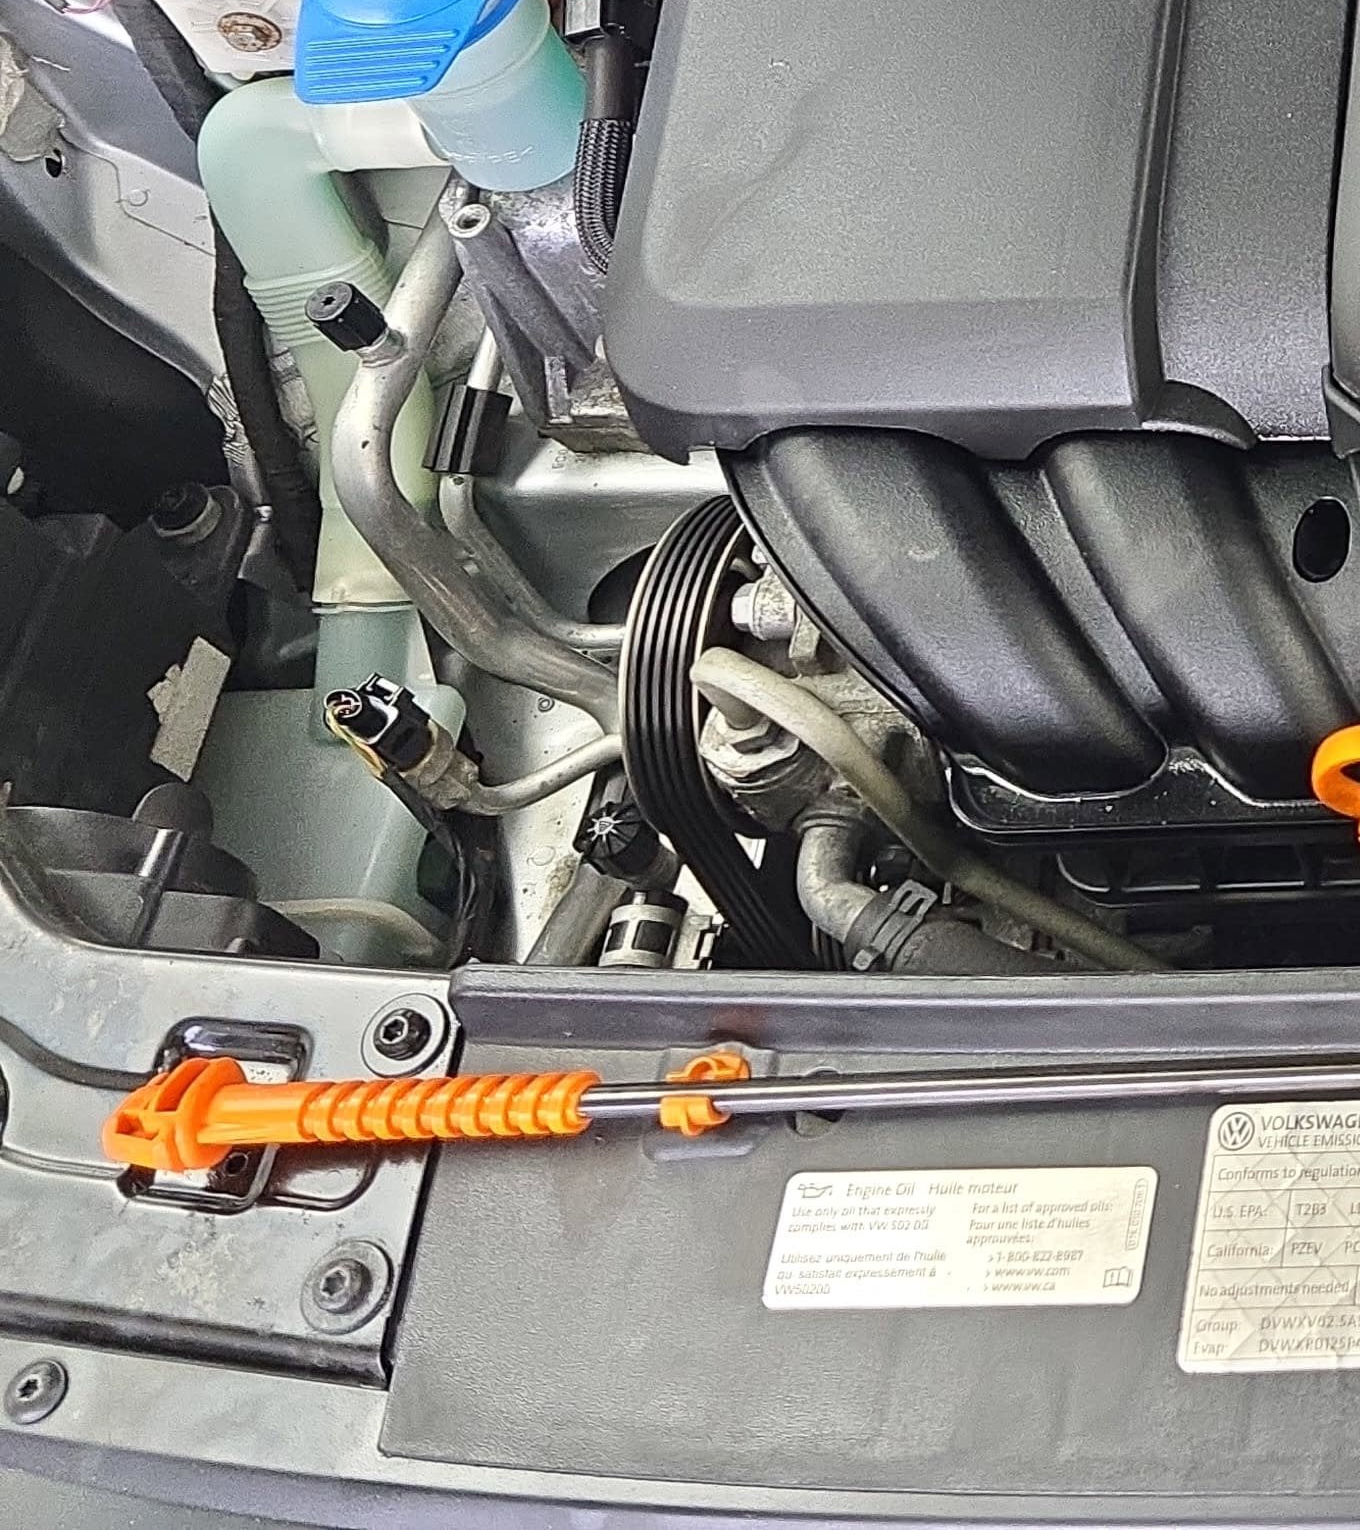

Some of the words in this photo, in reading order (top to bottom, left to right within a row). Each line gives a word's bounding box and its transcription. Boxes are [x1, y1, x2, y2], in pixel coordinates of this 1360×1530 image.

[1257, 1134, 1310, 1149] VEHICLE
[1218, 1167, 1279, 1181] Conforms
[1283, 1166, 1297, 1179] to
[846, 1183, 893, 1200] Engine
[895, 1182, 916, 1197] Oil
[928, 1182, 964, 1196] Huile
[967, 1181, 1020, 1195] moteur
[858, 1204, 881, 1217] that
[972, 1203, 991, 1214] For
[1001, 1201, 1018, 1214] list
[1020, 1201, 1035, 1214] of
[1035, 1200, 1088, 1216] approved
[1207, 1243, 1274, 1258] California:
[1291, 1241, 1323, 1255] PZEV
[1344, 1240, 1360, 1254] PC
[1199, 1284, 1219, 1297] No
[1220, 1282, 1300, 1300] adjustments
[1302, 1281, 1350, 1295] needed
